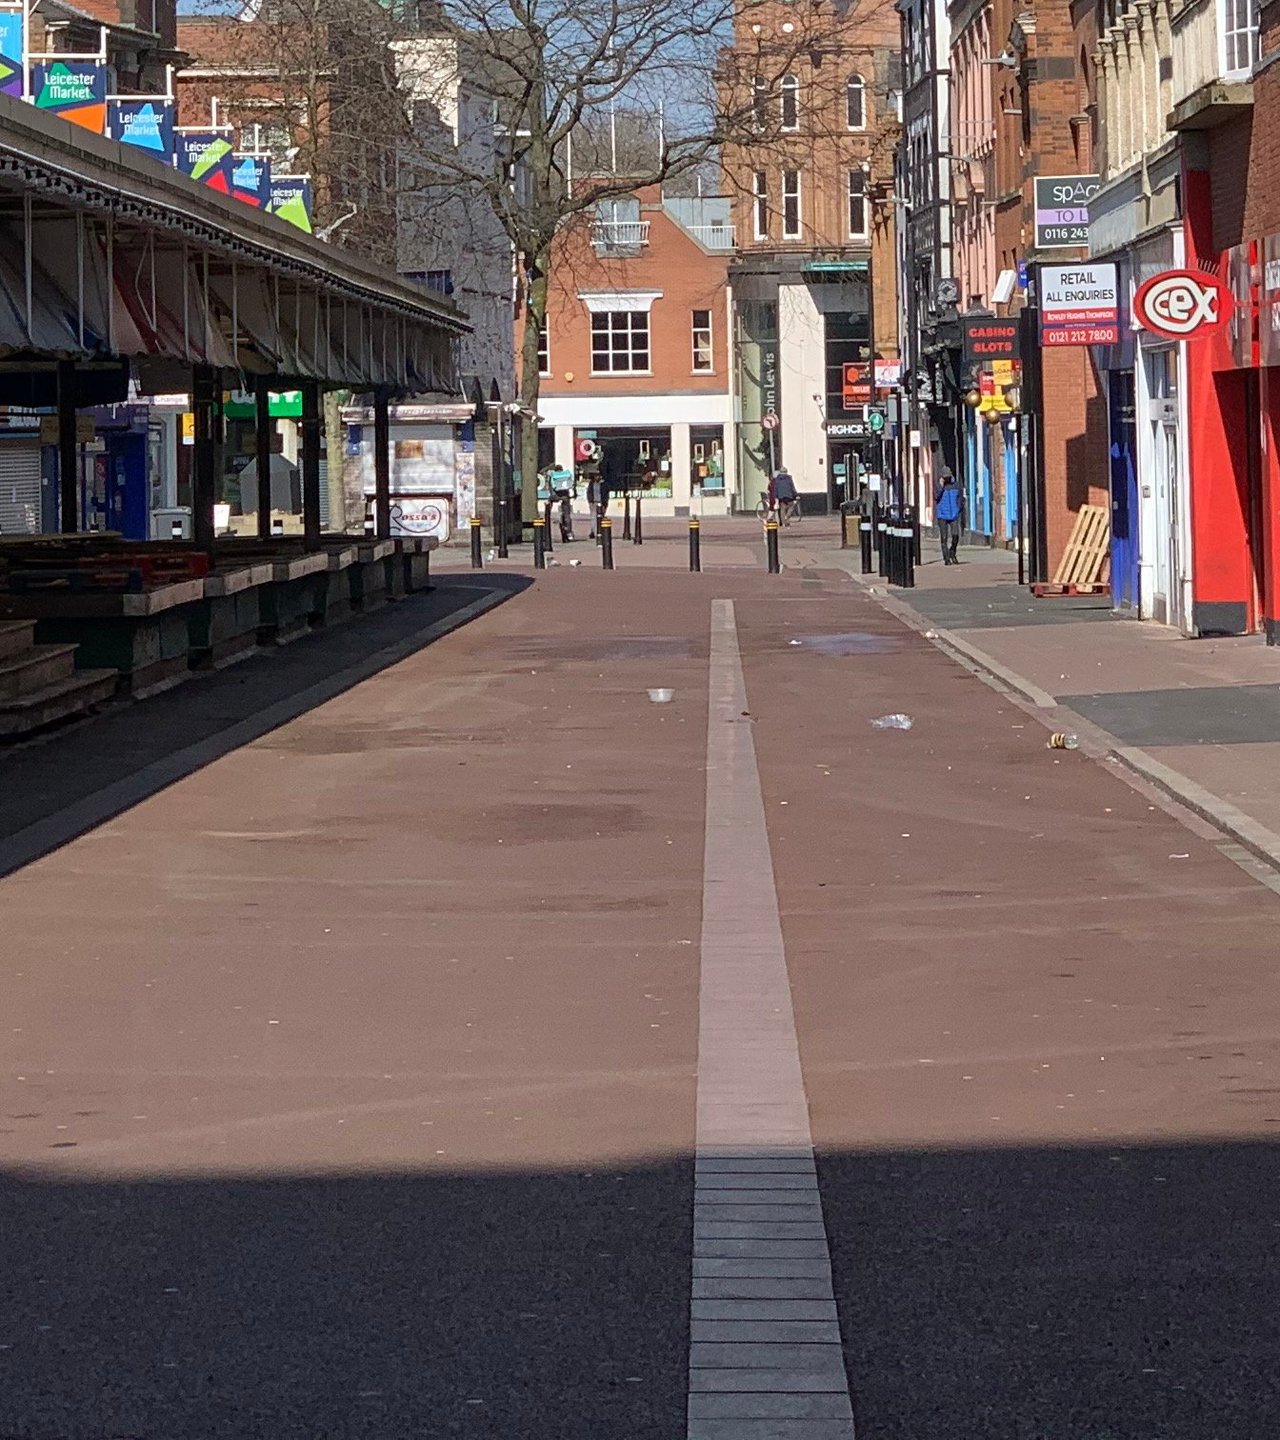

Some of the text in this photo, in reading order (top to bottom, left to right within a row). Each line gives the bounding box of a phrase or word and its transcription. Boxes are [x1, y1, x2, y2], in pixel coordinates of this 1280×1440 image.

[44, 72, 95, 85] Leicester
[49, 85, 91, 99] Market
[1056, 209, 1087, 222] TO L
[1045, 229, 1067, 239] 0116
[1060, 272, 1096, 285] RETAIL
[1046, 289, 1114, 303] ALL ENQUIRIES
[968, 327, 1015, 337] CASINO
[1049, 330, 1113, 342] 0121 212 7800
[973, 342, 1012, 352] SLOTS
[763, 353, 775, 416] ohn Lewis
